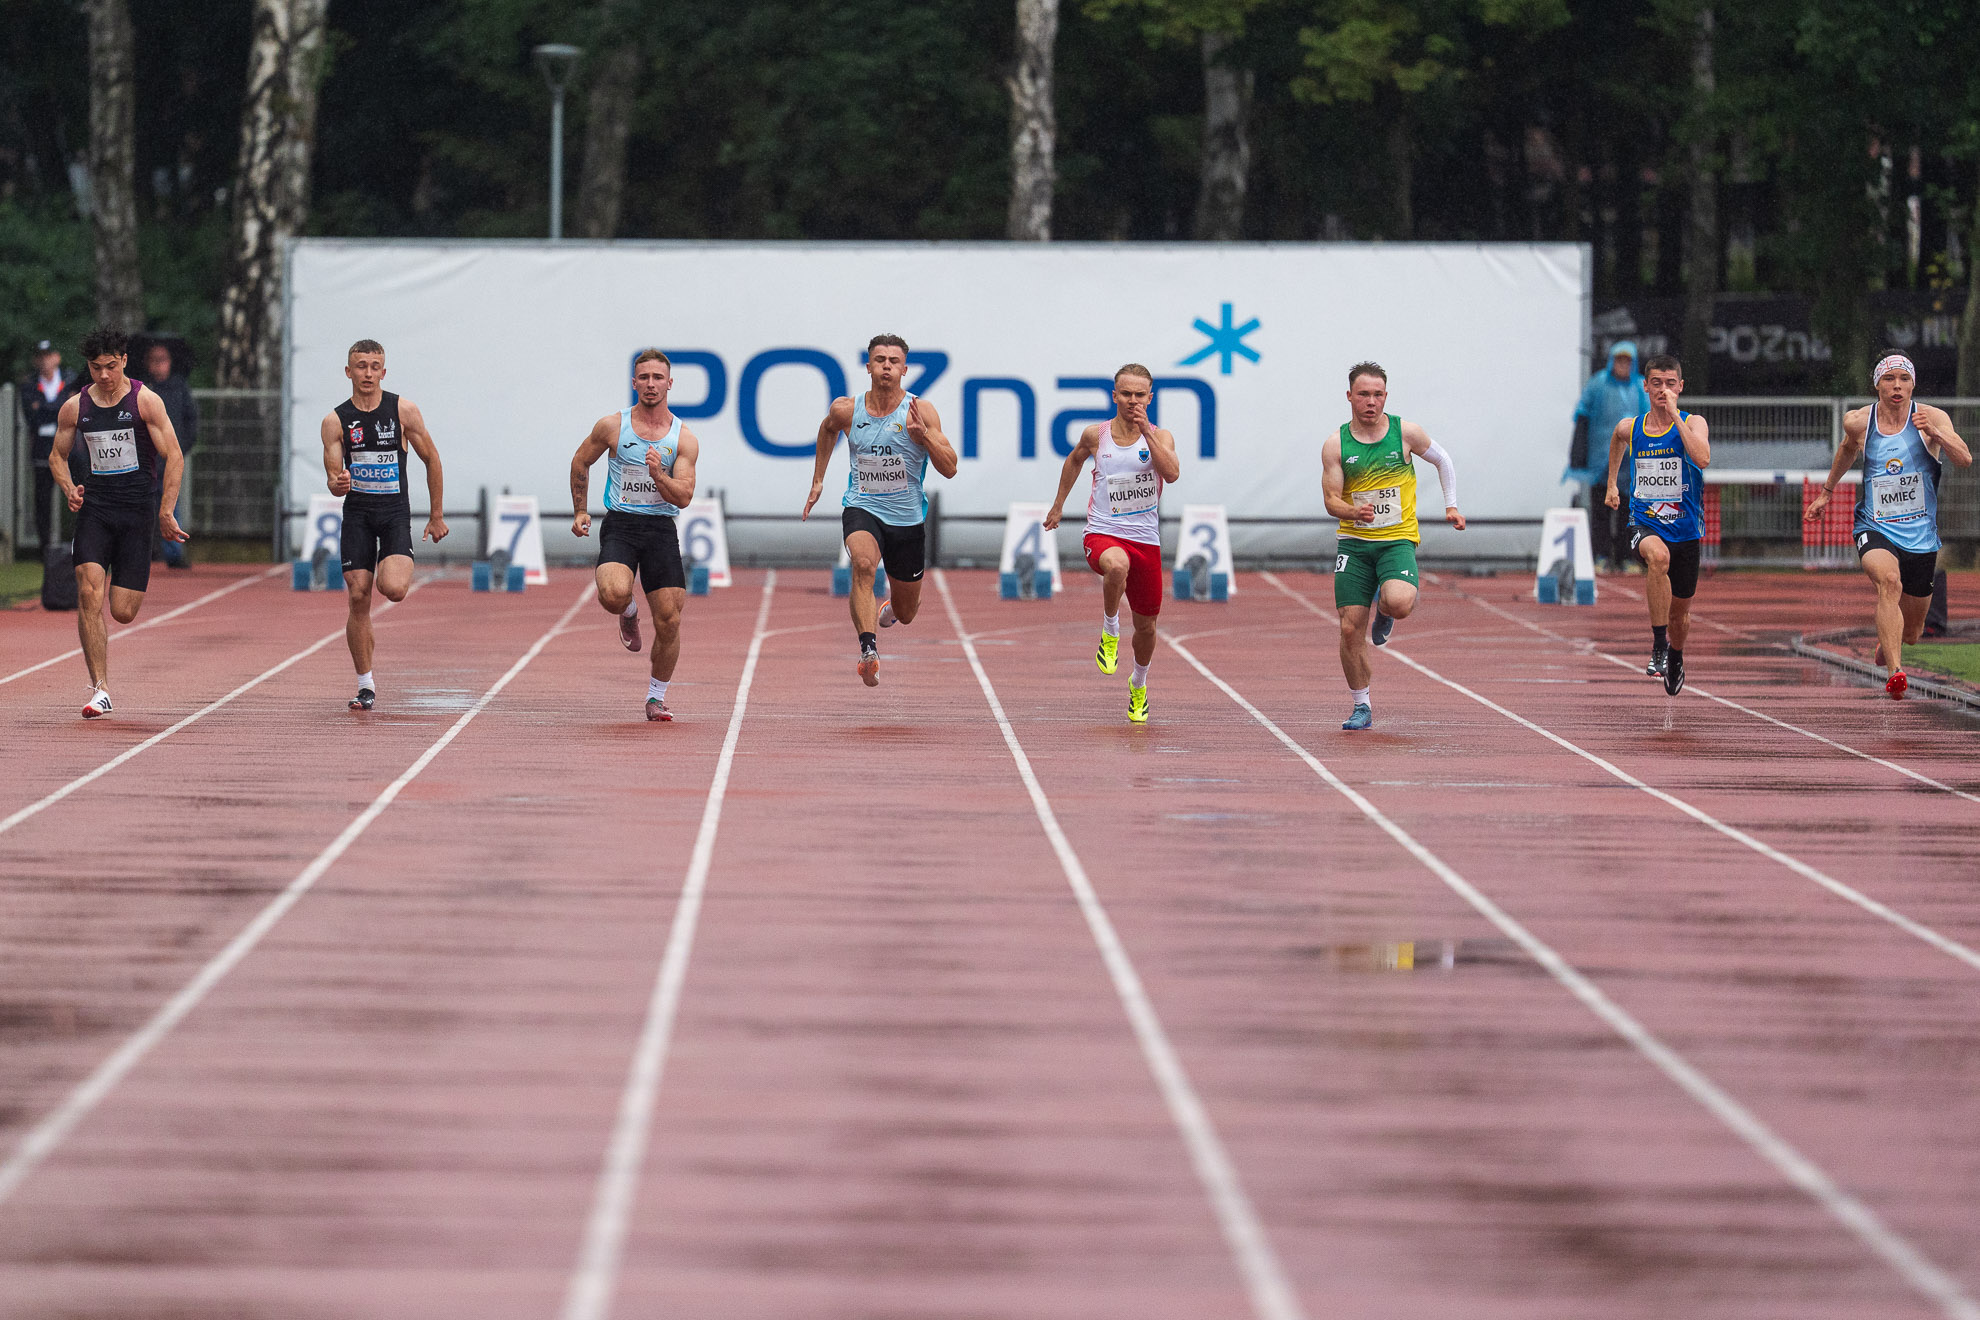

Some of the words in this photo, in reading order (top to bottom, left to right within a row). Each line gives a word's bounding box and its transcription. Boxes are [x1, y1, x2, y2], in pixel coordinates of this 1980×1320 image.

[111, 432, 130, 442] 461
[98, 447, 122, 459] LYSY
[377, 454, 394, 463] 370
[1637, 447, 1675, 458] KRUSZWICA
[882, 457, 901, 467] 236
[1659, 461, 1678, 471] 103
[353, 467, 396, 480] DOŁĘGA
[859, 470, 905, 482] DYMIŃSKI
[1135, 472, 1154, 484] 531
[621, 480, 658, 493] JASIŃS
[1638, 475, 1677, 487] PROCEK
[1899, 475, 1919, 486] 874
[1109, 485, 1156, 502] KULPIŃSKI
[1379, 488, 1396, 499] 551
[1880, 487, 1917, 505] KMIEĆ
[500, 515, 530, 565] 7
[684, 517, 714, 562] 6
[1013, 521, 1047, 569] 4
[1553, 526, 1575, 564] 1
[1190, 524, 1219, 568] 3
[1336, 555, 1344, 570] 3
